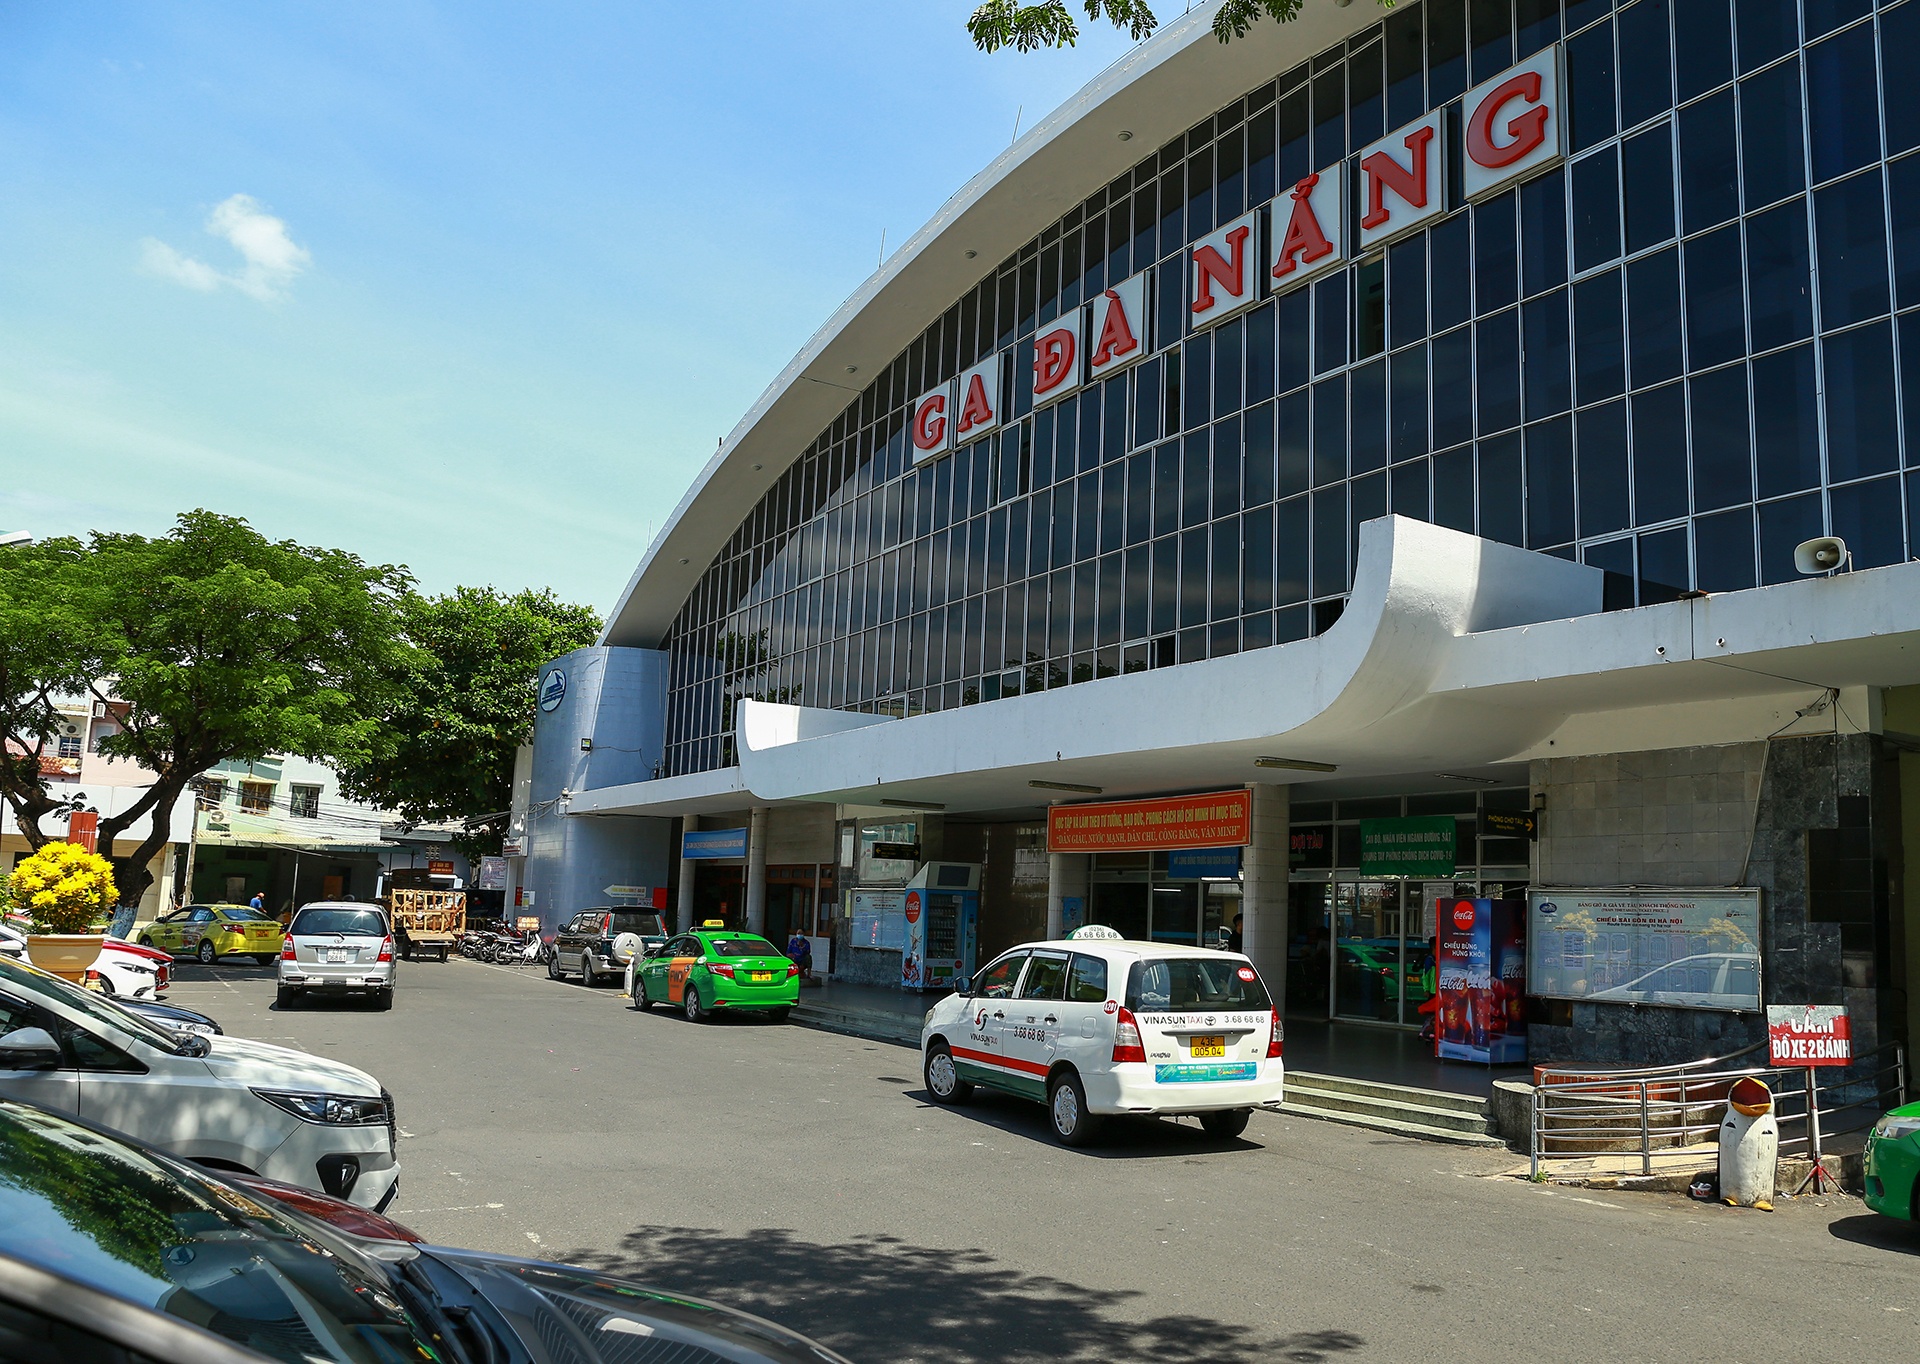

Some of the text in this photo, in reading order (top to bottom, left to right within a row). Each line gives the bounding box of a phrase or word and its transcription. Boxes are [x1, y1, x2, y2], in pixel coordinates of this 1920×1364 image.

[912, 71, 1549, 450] GA ĐÀ NẴNG
[1090, 815, 1100, 828] THEO
[1146, 811, 1163, 826] PHONG
[1163, 807, 1177, 825] CÁCH
[1185, 805, 1194, 822] CHÍ
[1194, 806, 1209, 822] MINH
[1216, 805, 1229, 823] MỤC
[1127, 829, 1141, 843] DÂN
[1158, 827, 1178, 841] CÔNG
[1201, 825, 1216, 838] VĂN
[1430, 850, 1453, 861] COVID-19
[1224, 1016, 1265, 1024] 3.68 68 68
[1036, 1030, 1046, 1042] 68
[1200, 1037, 1216, 1046] 43E
[1194, 1046, 1222, 1056] 005.04
